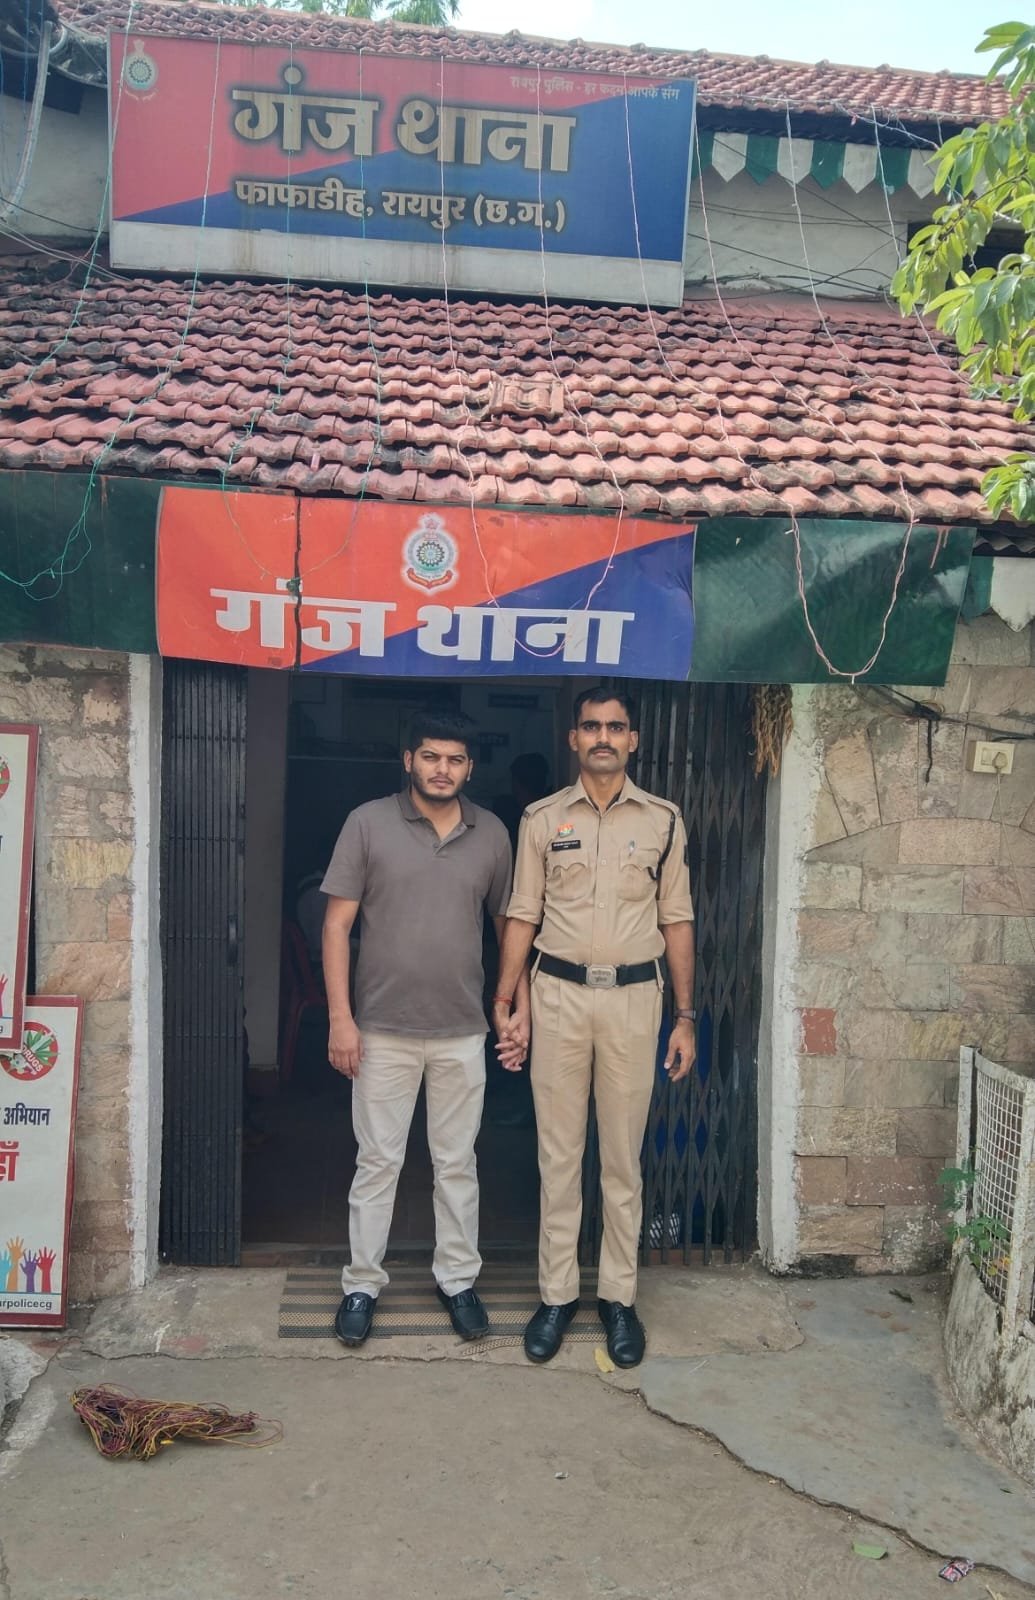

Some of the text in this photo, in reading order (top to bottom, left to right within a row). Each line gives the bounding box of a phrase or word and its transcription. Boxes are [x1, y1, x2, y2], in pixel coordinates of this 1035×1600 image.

[661, 86, 681, 101] संग
[231, 65, 577, 172] गंज थाना
[382, 190, 465, 229] रायपुर
[473, 193, 566, 233] (छ.ग.)
[210, 578, 635, 665] गंज थाना
[3, 1102, 51, 1126] अभियान
